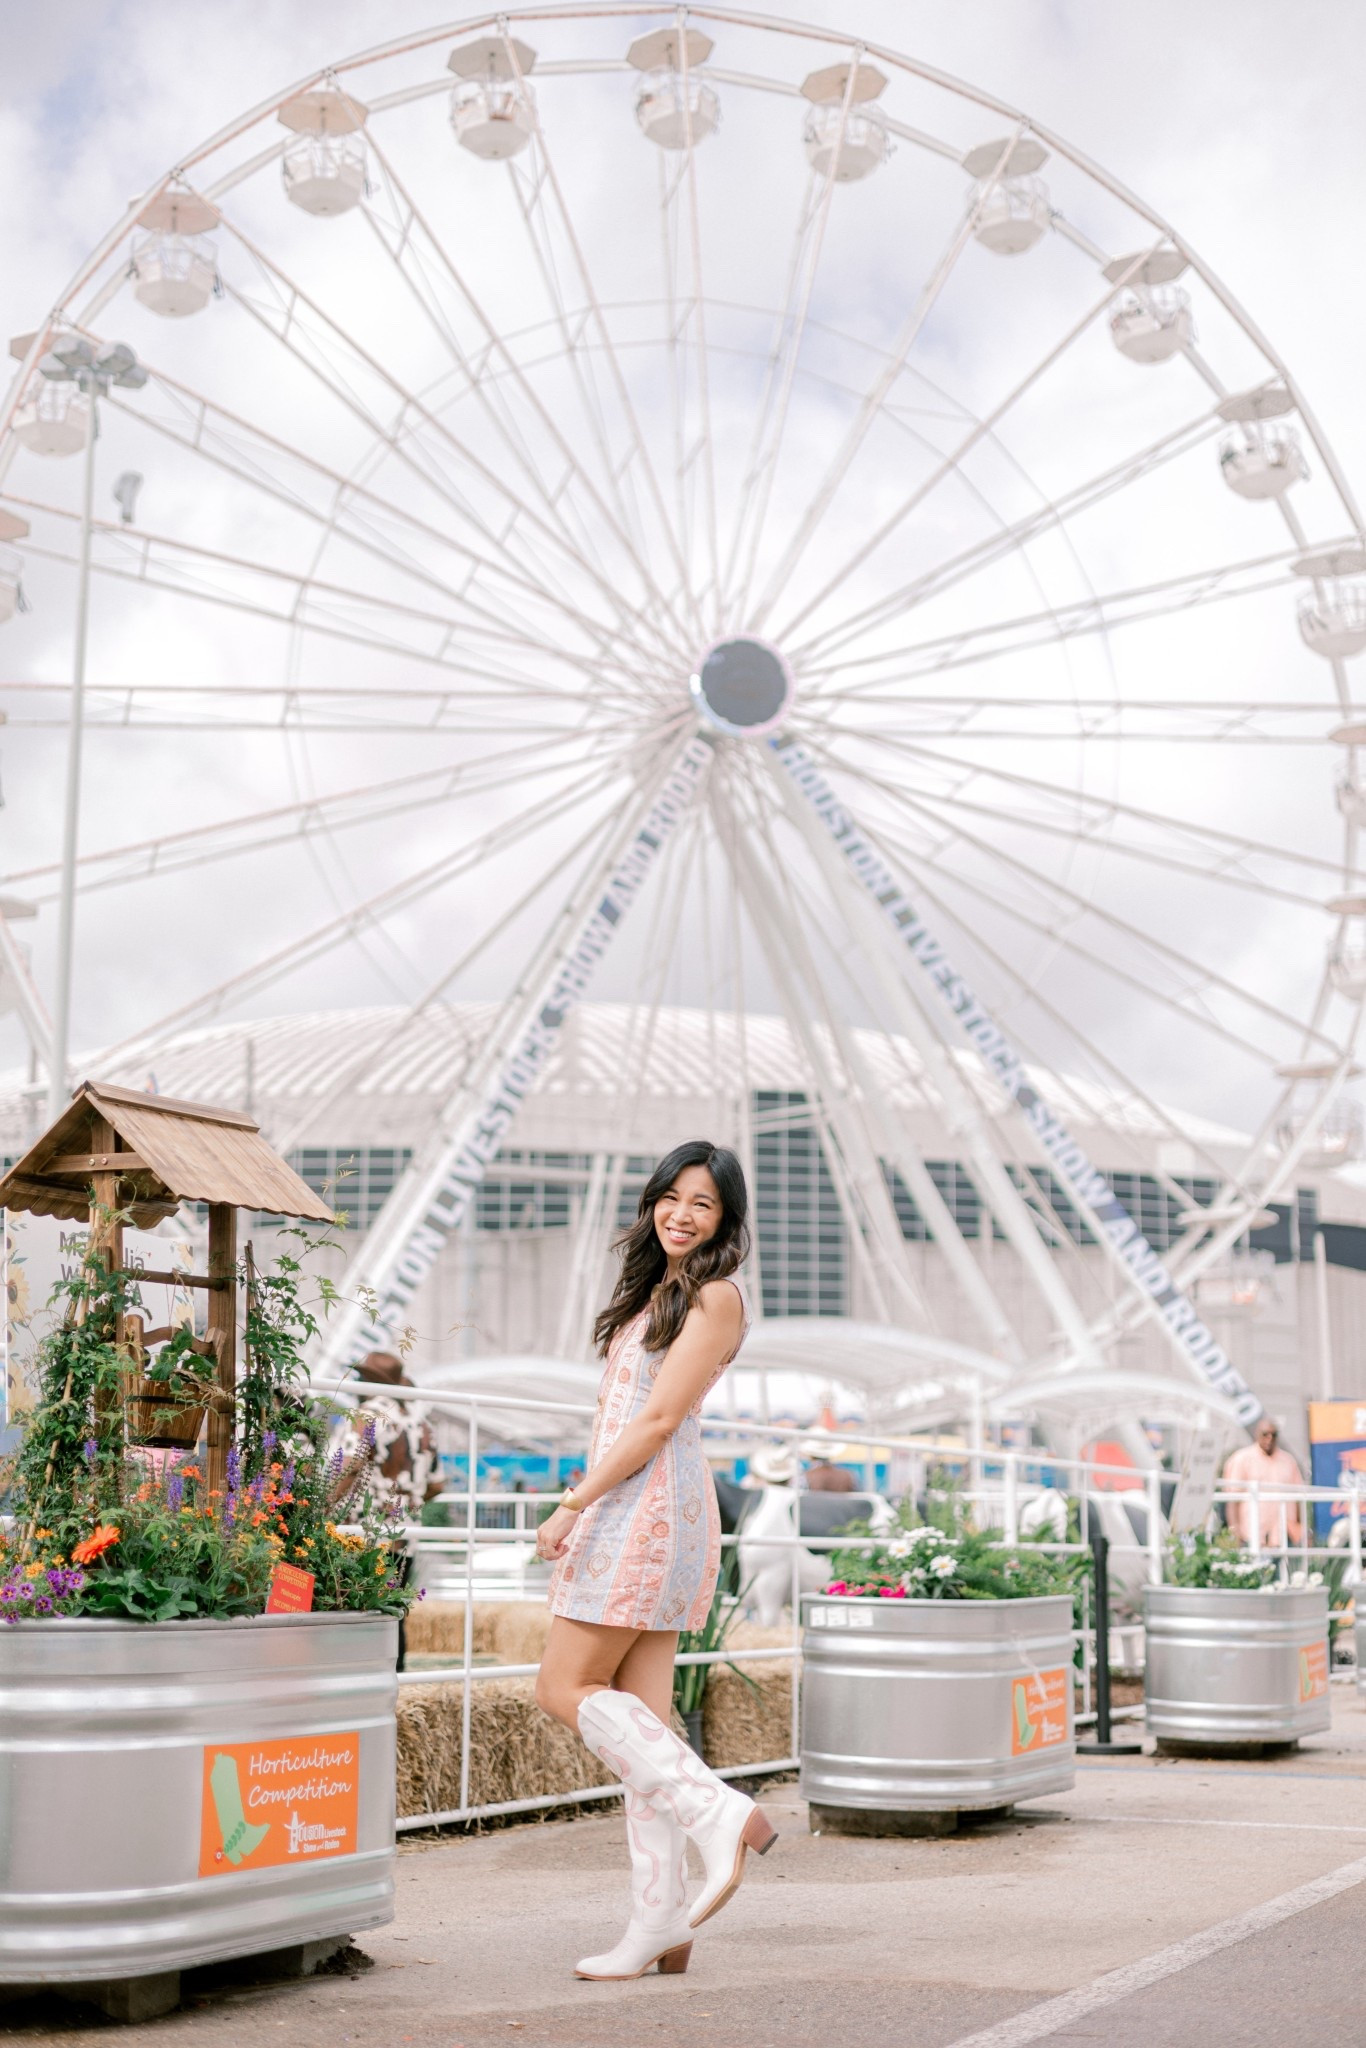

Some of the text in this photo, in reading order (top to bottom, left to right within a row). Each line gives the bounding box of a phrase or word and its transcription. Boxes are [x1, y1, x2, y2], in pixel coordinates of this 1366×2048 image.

[430, 1018, 561, 1229] LIVESTOCK
[551, 908, 618, 1014] SHOW
[608, 840, 658, 907] AND
[649, 735, 715, 839] RODEO
[779, 747, 1263, 1427] HOUSTON LIVESTOCK SHOW AND RODEO
[273, 1598, 292, 1612] SECOND
[250, 1748, 353, 1776] Horticulture
[248, 1777, 352, 1808] Competition
